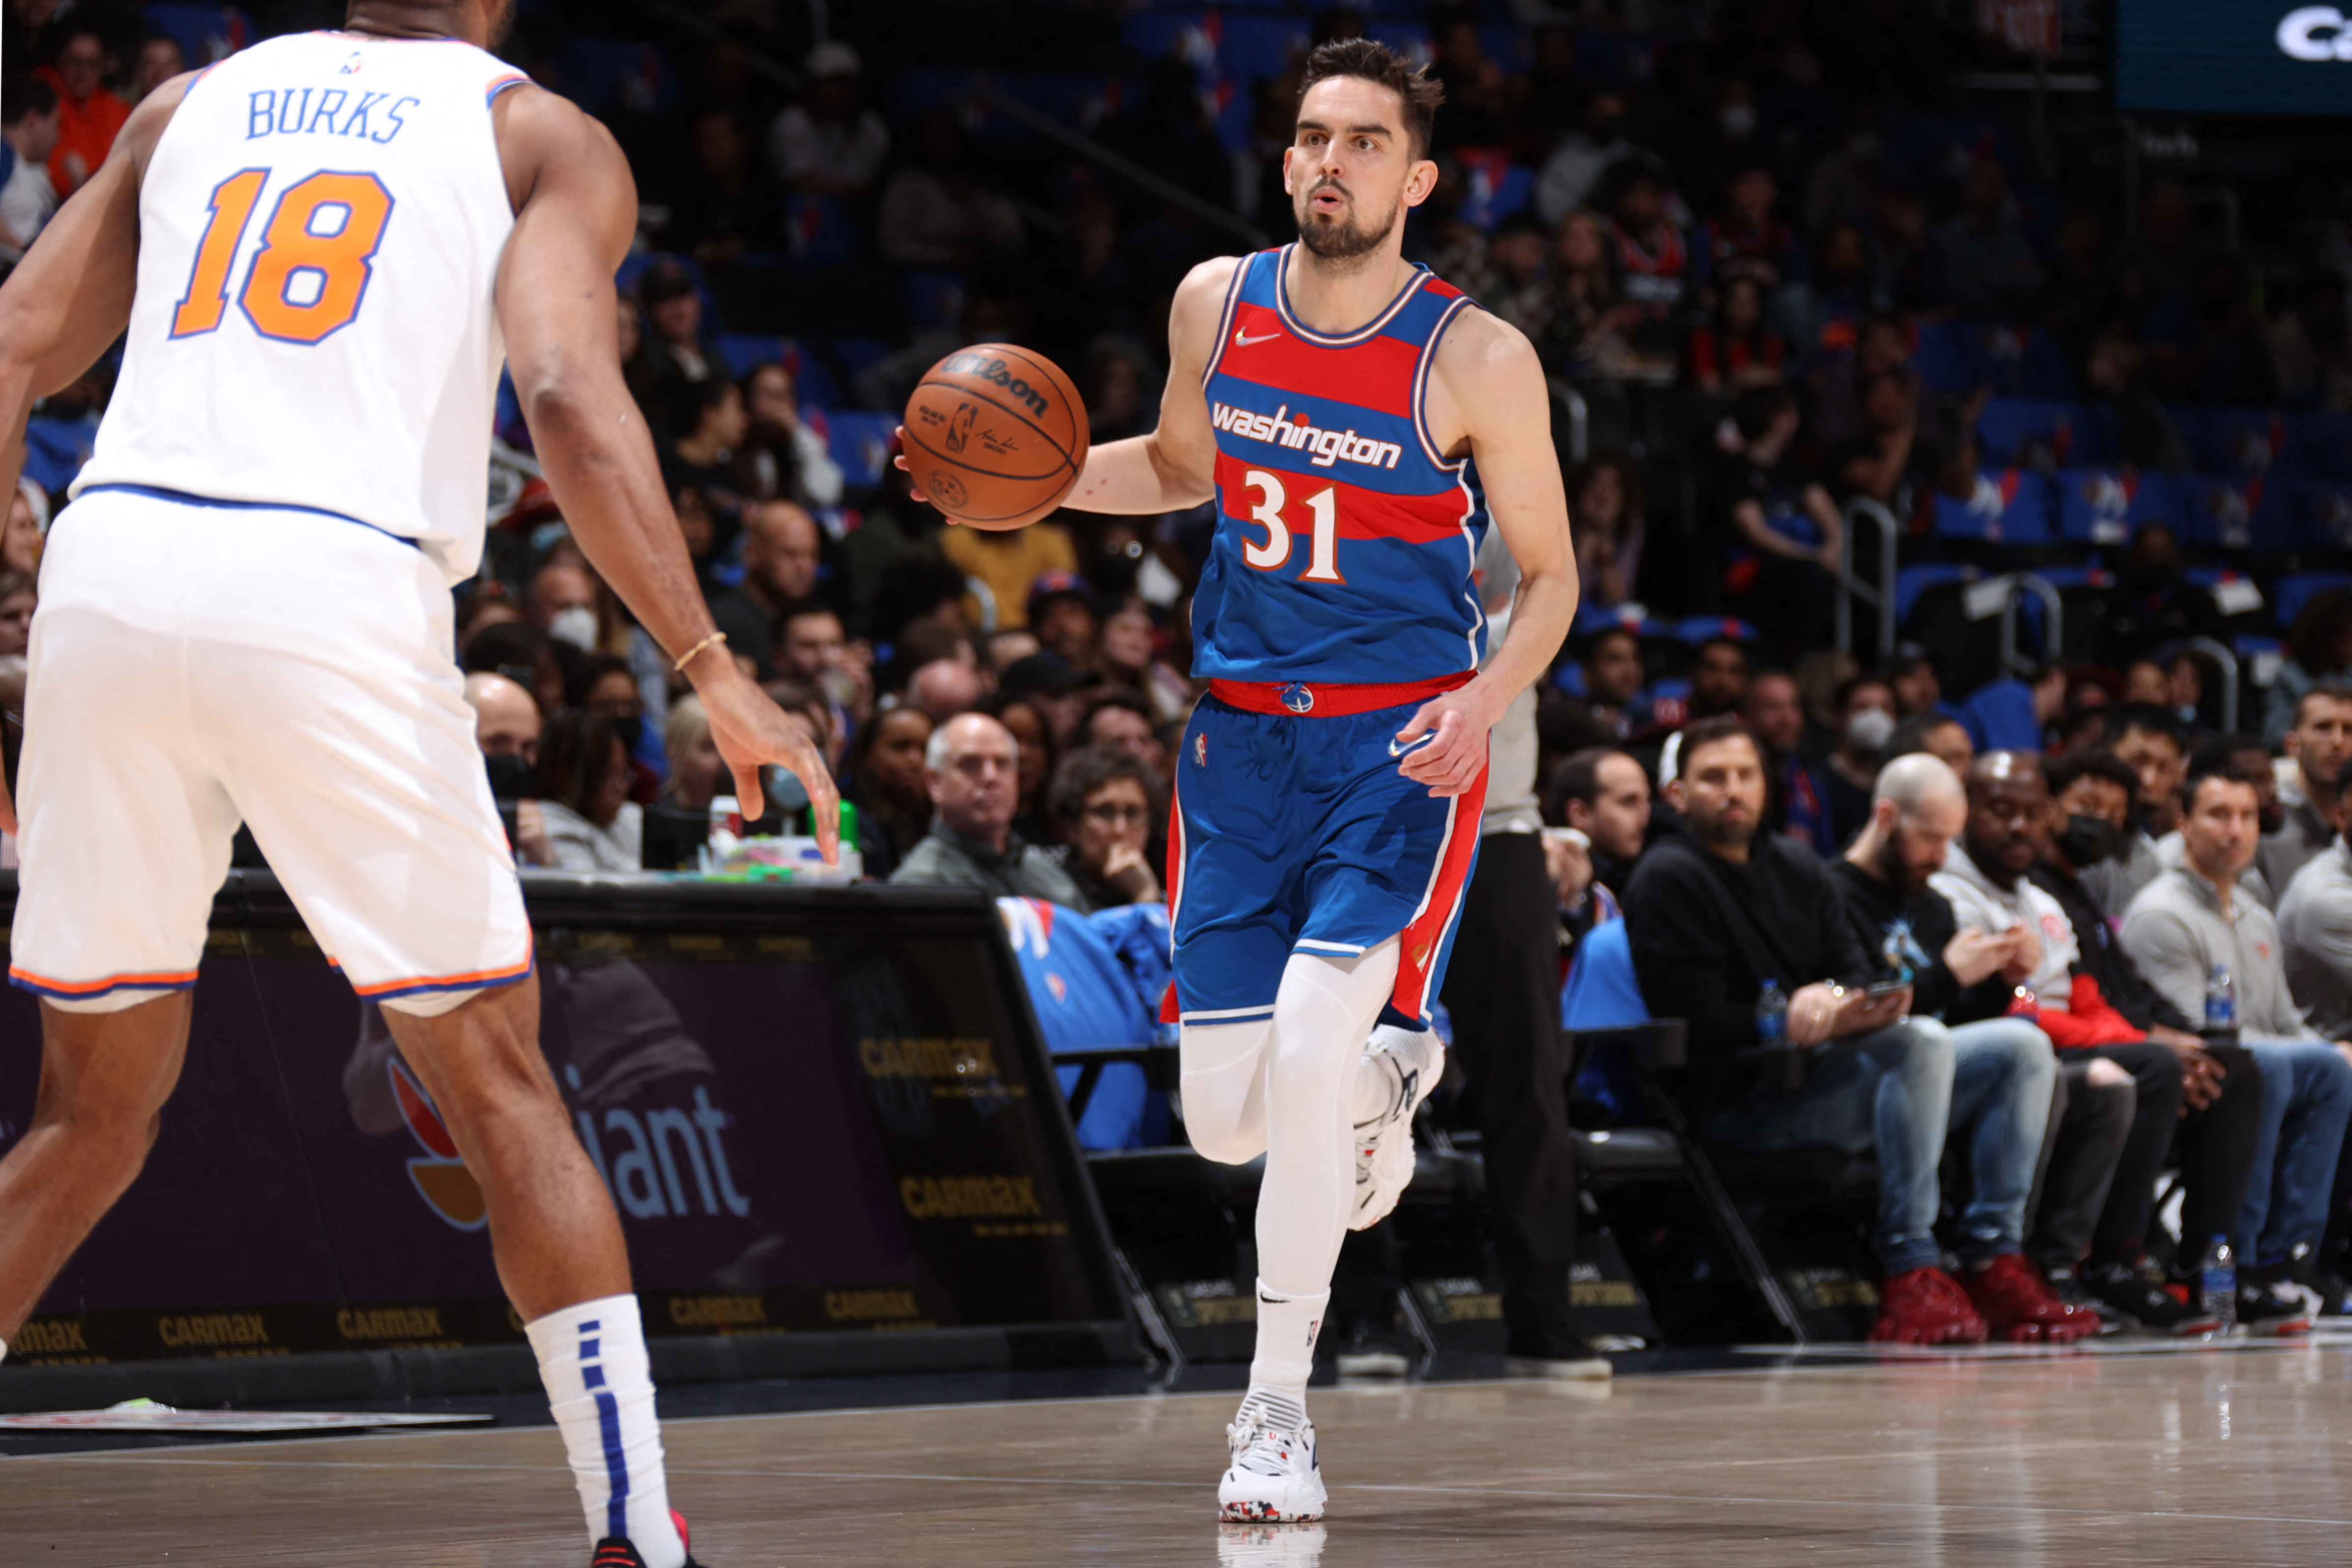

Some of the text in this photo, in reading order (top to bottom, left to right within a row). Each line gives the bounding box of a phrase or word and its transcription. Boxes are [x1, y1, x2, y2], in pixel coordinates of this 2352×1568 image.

[247, 88, 419, 144] BURKS
[167, 167, 395, 346] 18
[1211, 401, 1403, 470] washington
[1241, 466, 1348, 585] 31
[565, 1064, 750, 1219] iant
